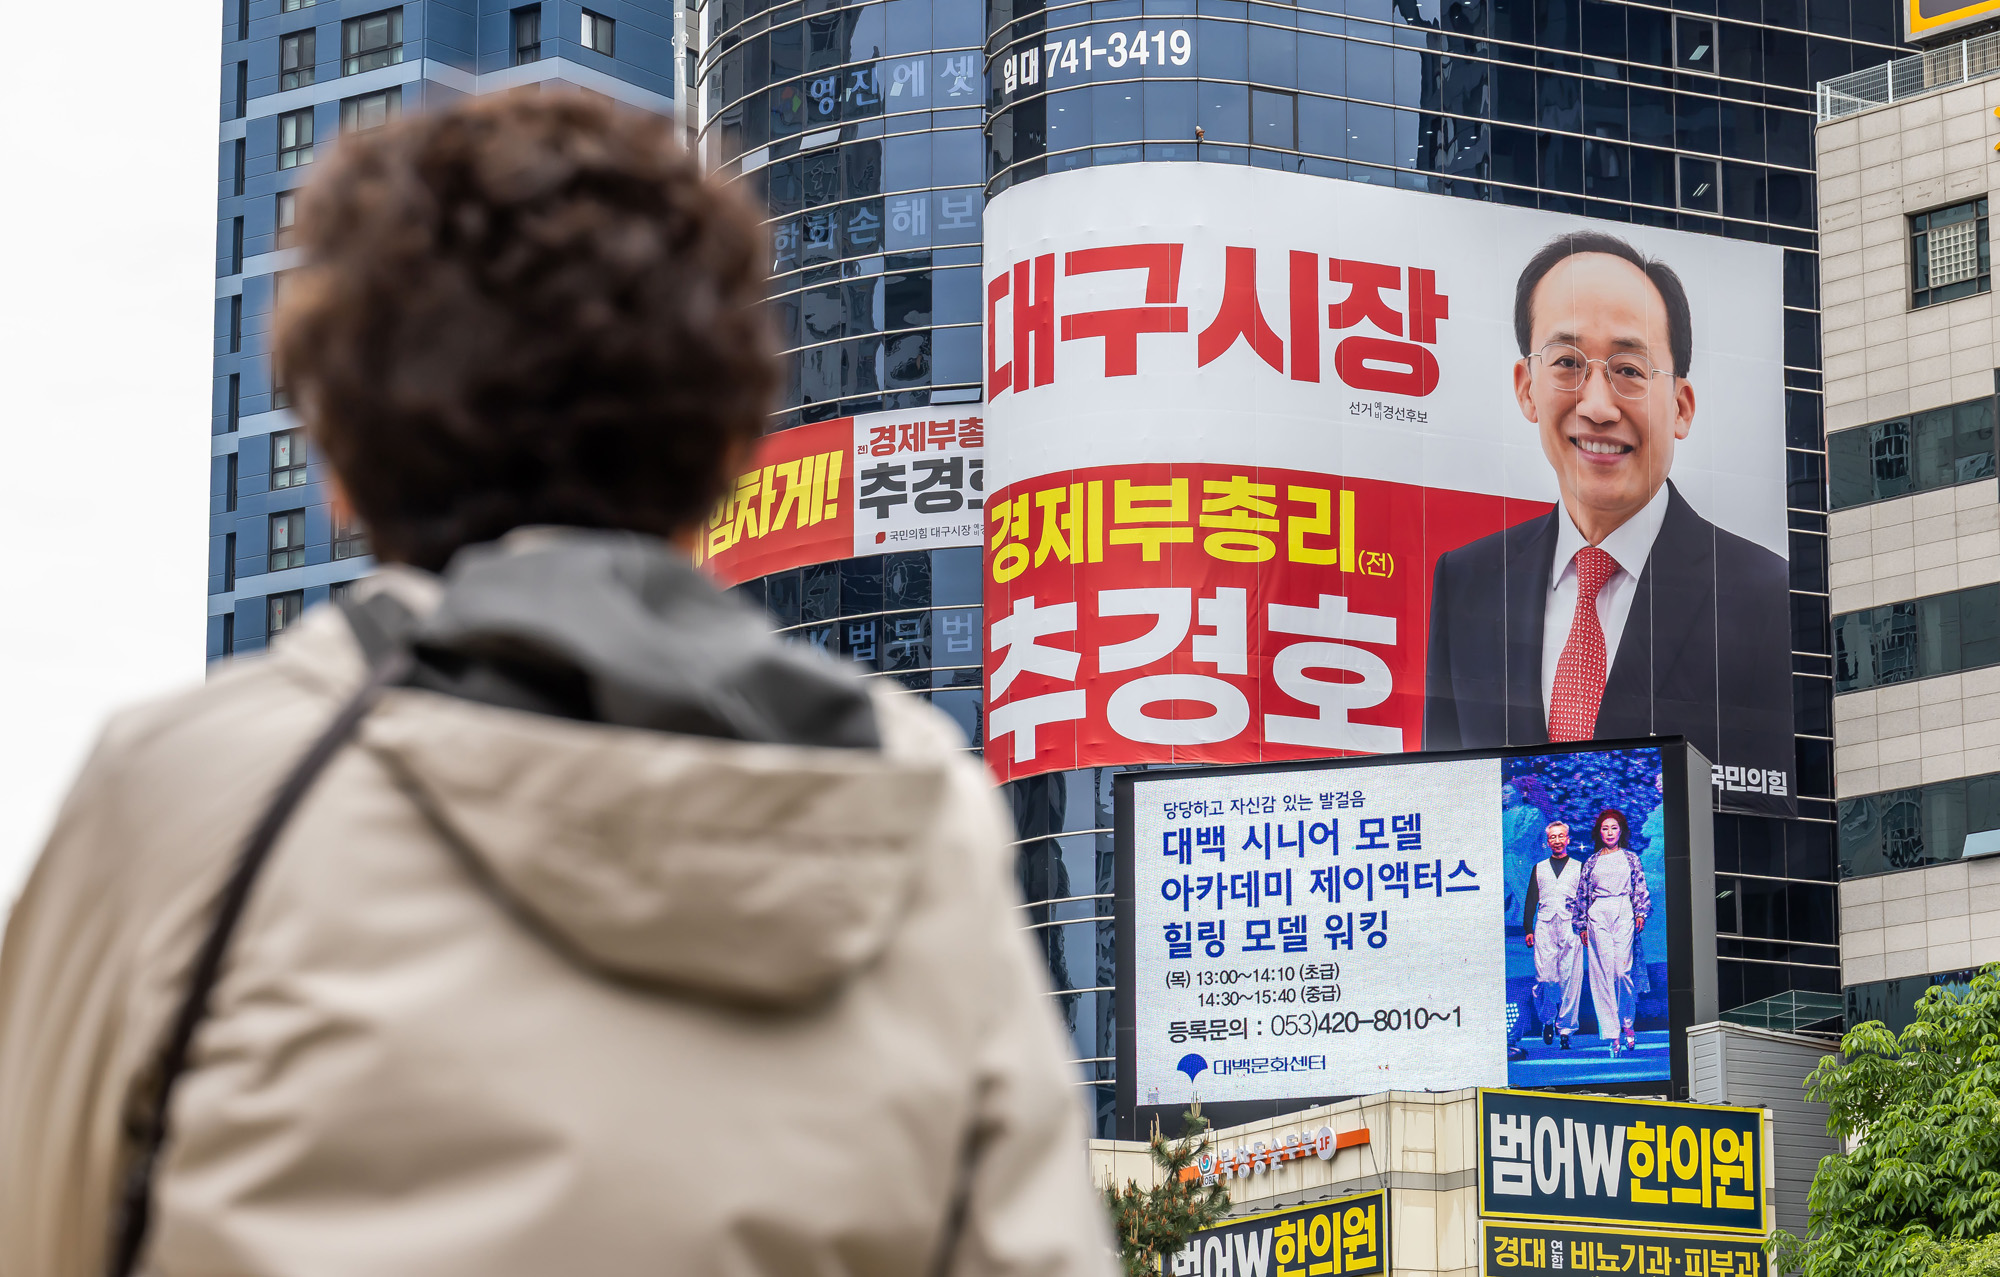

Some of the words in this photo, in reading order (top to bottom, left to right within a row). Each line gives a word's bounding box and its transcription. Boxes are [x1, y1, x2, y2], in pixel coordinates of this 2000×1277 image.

[1003, 47, 1039, 95] 임대
[1044, 29, 1191, 78] 741-3419
[987, 243, 1449, 406] 대구시장
[889, 527, 928, 542] 국민의힘
[930, 524, 971, 538] 대구시장
[989, 586, 1404, 763] 추경호
[1711, 764, 1787, 796] 국민의힘
[1163, 800, 1224, 820] 당당하고
[1230, 796, 1276, 815] 자신감
[1283, 794, 1313, 812] 있는
[1319, 790, 1366, 810] 발걸음
[1163, 825, 1225, 865] 대백
[1242, 818, 1339, 860] 시니어
[1355, 813, 1422, 851] 모델
[1161, 868, 1292, 912] 아카데미
[1310, 859, 1480, 903] 제이액터스
[1163, 920, 1225, 959] 힐링
[1242, 915, 1308, 953] 모델
[1324, 910, 1388, 950] 워킹
[1165, 970, 1191, 989] (목)
[1196, 966, 1295, 986] 13:00~14:10
[1299, 962, 1340, 982] (초급)
[1198, 988, 1296, 1007] 14:30~15:40
[1300, 984, 1341, 1004] (중급)
[1167, 1017, 1248, 1043] 등록문의
[1213, 1055, 1326, 1076] 대백문화센터
[1319, 1135, 1331, 1151] 1F
[1490, 1113, 1755, 1210] 범어W한의원
[1494, 1236, 1546, 1268] 경대
